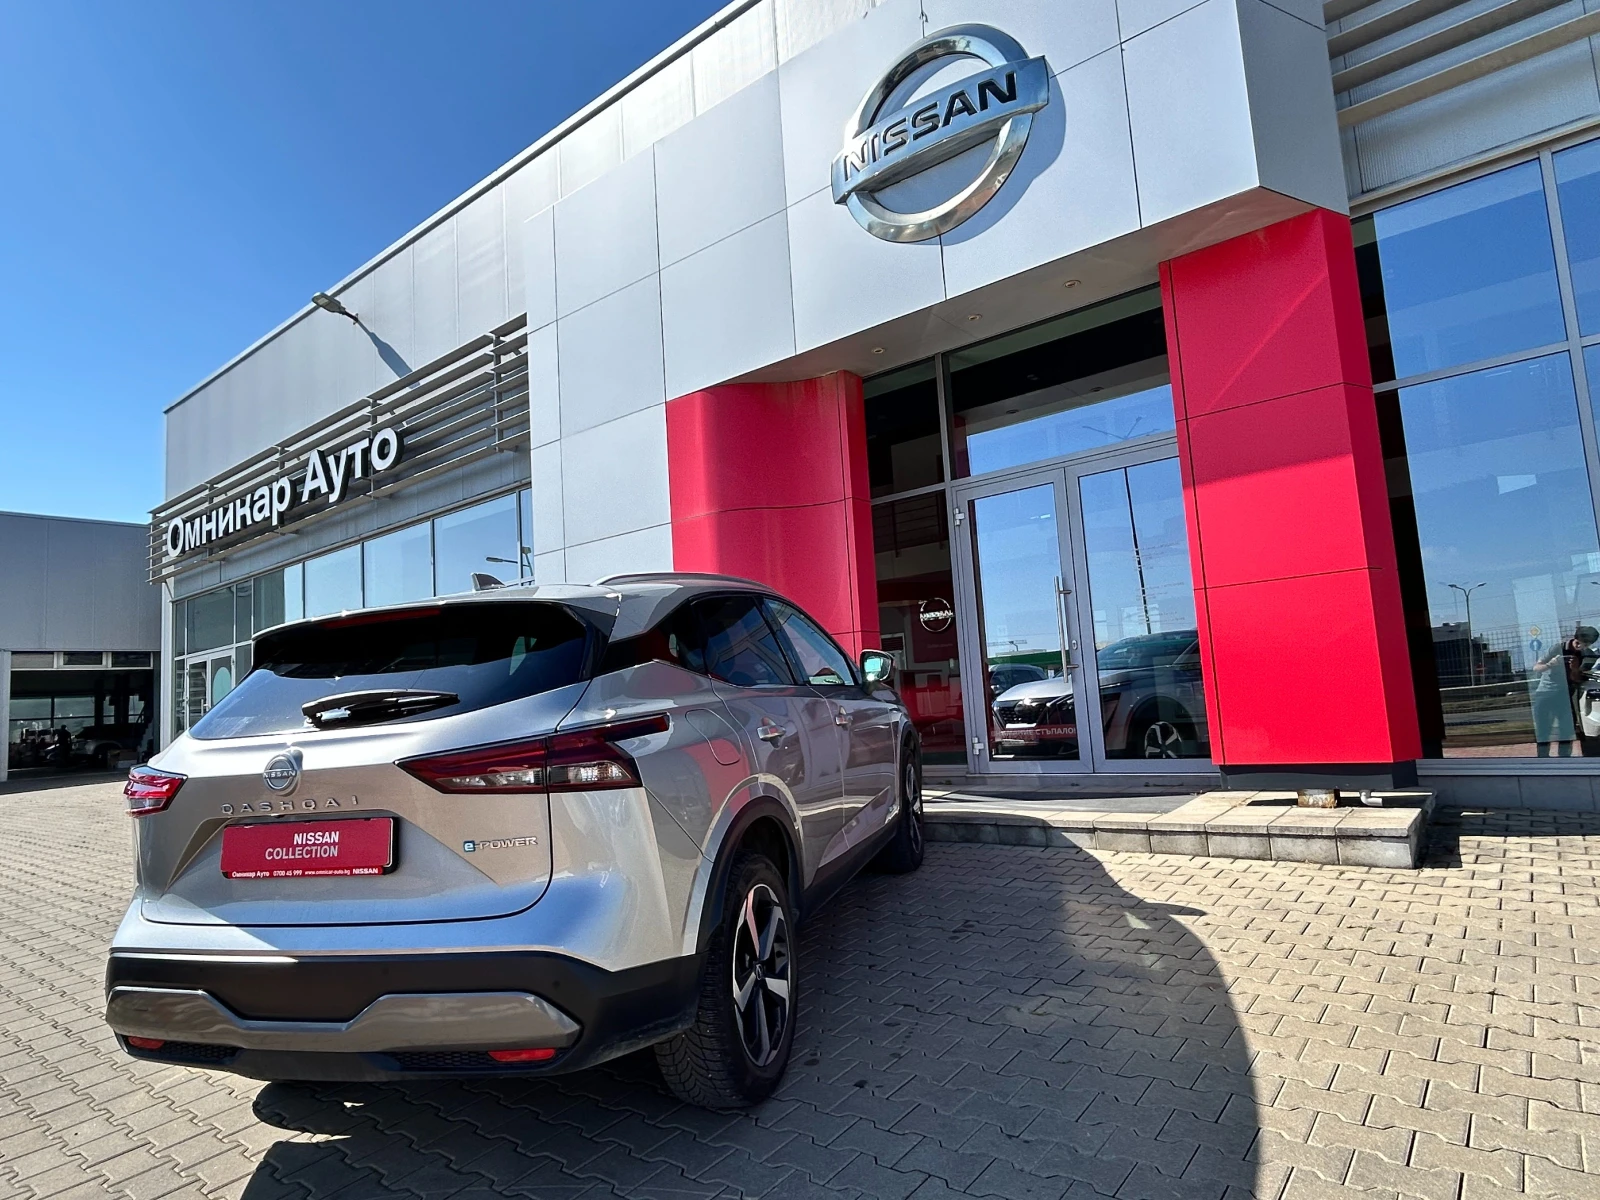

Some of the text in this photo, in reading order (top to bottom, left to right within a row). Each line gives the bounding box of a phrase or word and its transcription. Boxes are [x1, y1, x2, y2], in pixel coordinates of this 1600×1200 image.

[843, 70, 1017, 182] NISSAN
[166, 427, 399, 558] Омникар Ауто
[221, 795, 359, 815] QASHQAI
[293, 831, 339, 845] NISSAN
[464, 836, 538, 852] e-POWER
[265, 845, 338, 860] COLLECTION
[256, 870, 270, 878] Ауто
[352, 867, 379, 875] NISSAN
